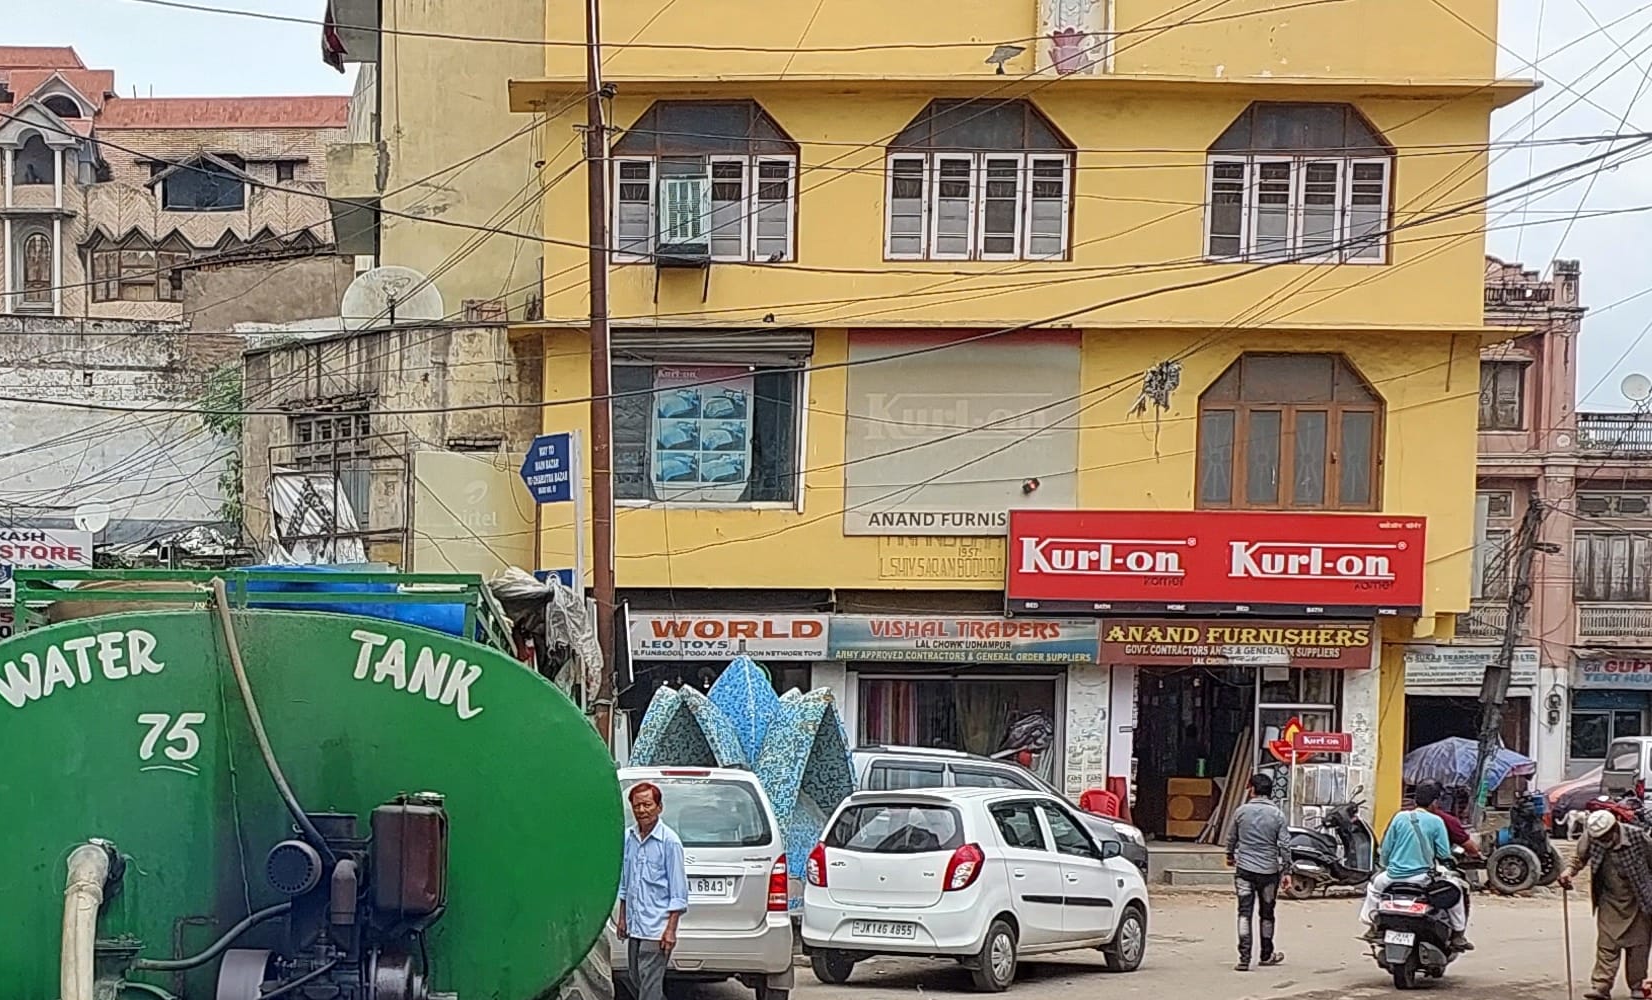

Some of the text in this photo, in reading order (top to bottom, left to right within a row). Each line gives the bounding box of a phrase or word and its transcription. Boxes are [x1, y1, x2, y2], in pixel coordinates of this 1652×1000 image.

[868, 512, 1007, 527] ANAND FURNIS
[1018, 537, 1396, 581] Kurl-on Kurl-on
[650, 620, 823, 639] WORLD
[869, 620, 1061, 639] VISHAL TRADERS
[1105, 625, 1370, 647] ANAND FURNISHERS
[682, 640, 728, 649] TOYS
[915, 640, 1011, 650] LAL CHOWK UDHAMPUR
[1150, 645, 1209, 656] CONTRACTORS
[1297, 648, 1340, 658] SUPPLIERS
[835, 650, 859, 659] ARMY
[860, 651, 904, 660] APPROVED
[905, 651, 966, 661] CONTRACTORS
[976, 652, 1014, 662] GENERAL
[1016, 652, 1045, 662] ORDER
[1046, 653, 1092, 662] SUPPLIERS
[350, 629, 483, 719] TANK
[137, 712, 207, 761] 75
[697, 880, 723, 892] 6843
